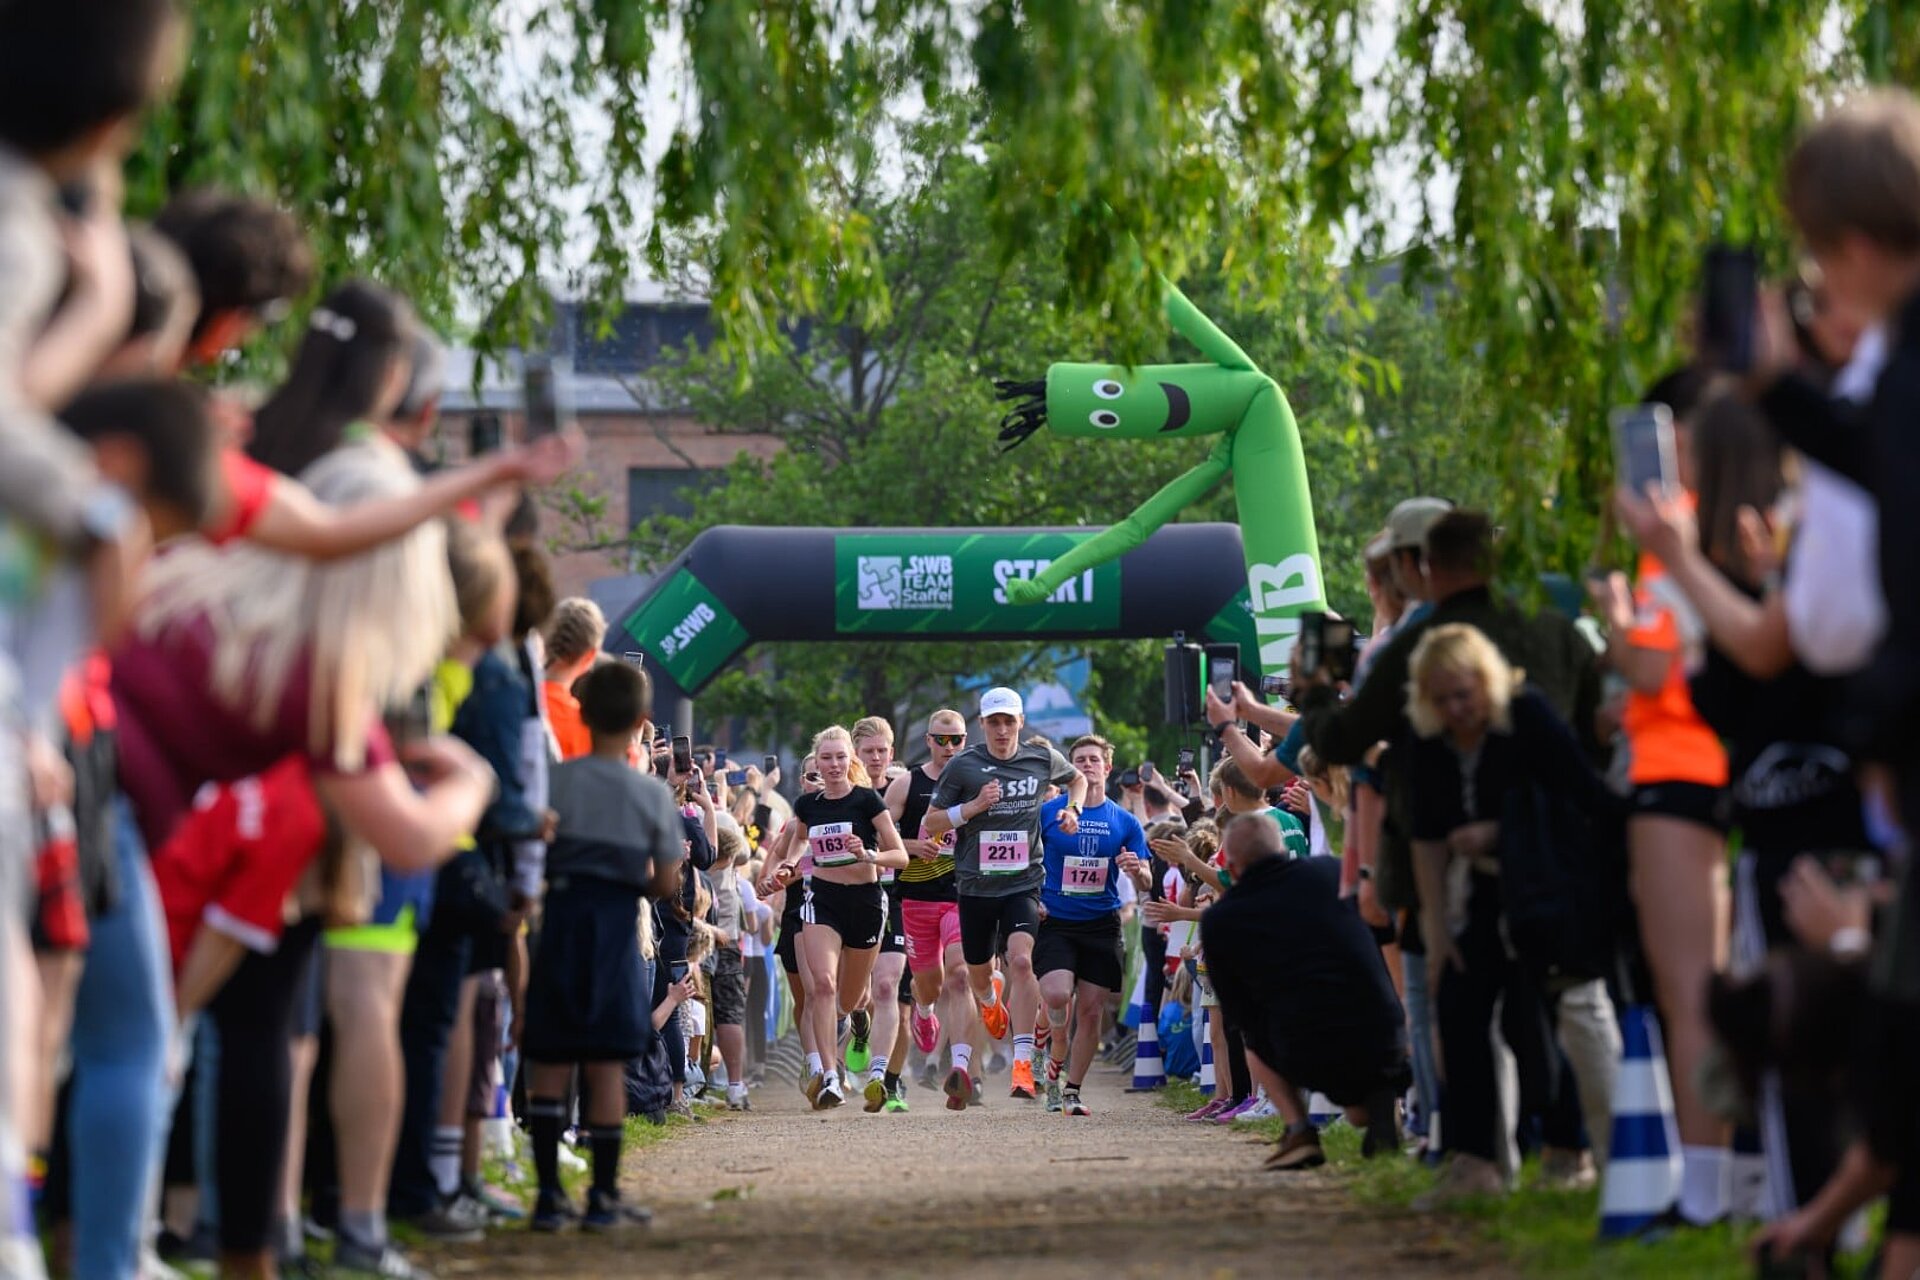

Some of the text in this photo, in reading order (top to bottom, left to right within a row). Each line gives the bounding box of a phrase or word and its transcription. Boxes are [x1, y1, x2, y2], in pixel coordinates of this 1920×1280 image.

[903, 555, 952, 576] StWB
[903, 574, 952, 589] TEAM
[902, 588, 952, 603] Staffel
[1007, 776, 1038, 797] ssb
[816, 837, 844, 853] 163
[988, 845, 1016, 860] 221
[1071, 869, 1097, 884] 174
